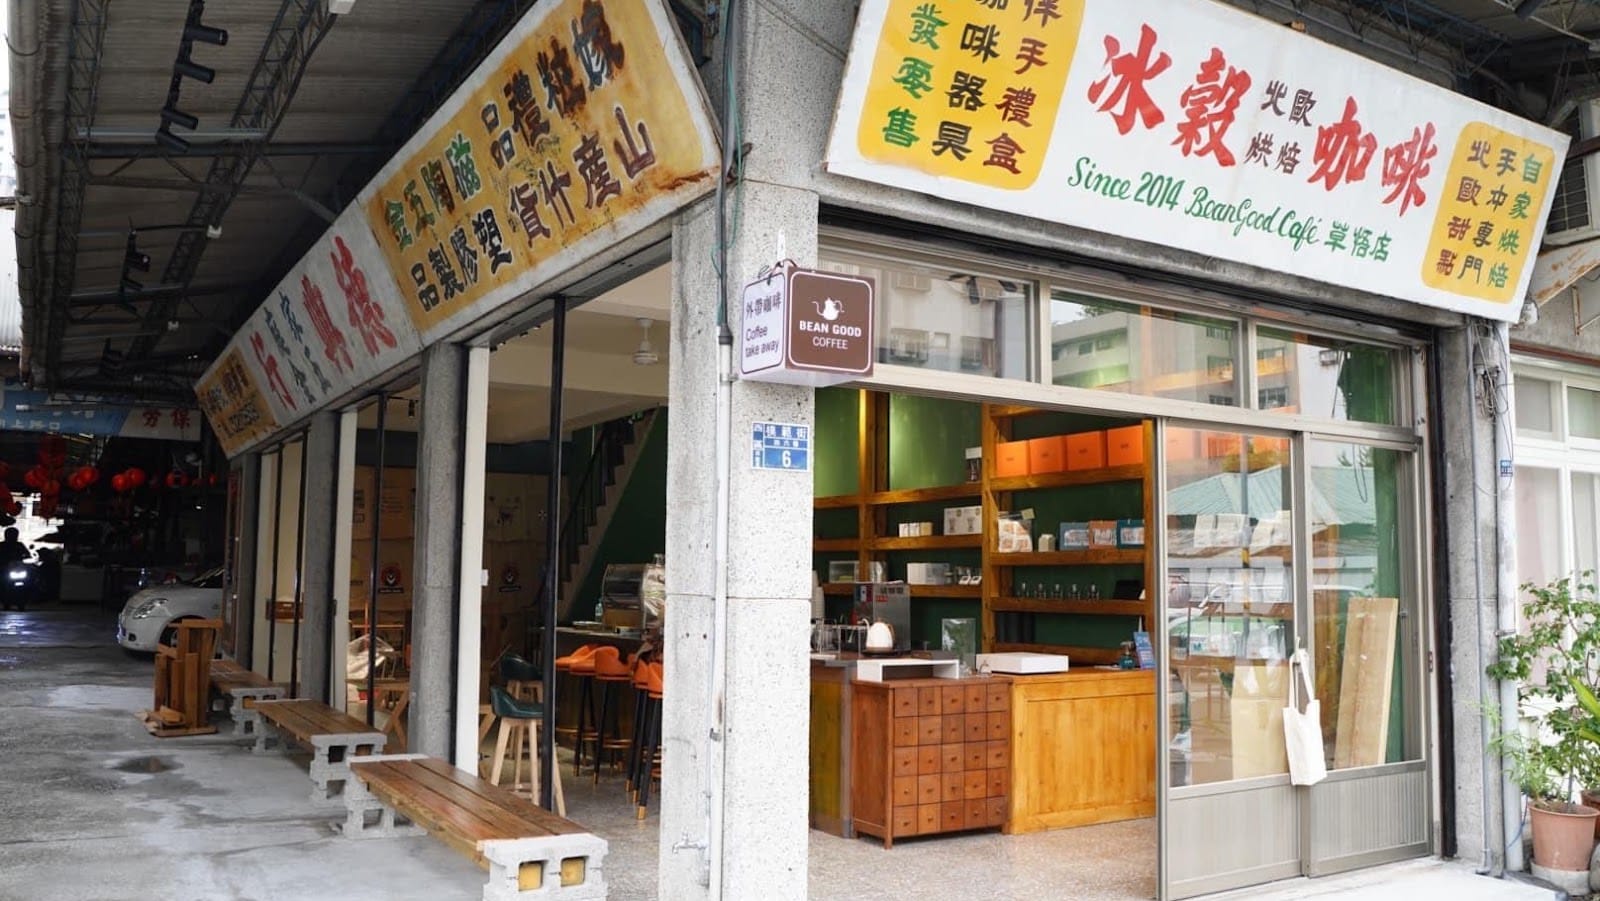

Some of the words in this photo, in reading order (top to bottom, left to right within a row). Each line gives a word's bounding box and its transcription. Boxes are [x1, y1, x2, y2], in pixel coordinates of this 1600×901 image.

[931, 0, 1008, 161] 啡器具
[1261, 80, 1316, 127] 北歐
[1243, 132, 1301, 174] 烘焙
[1308, 95, 1438, 216] 咖啡
[1068, 156, 1131, 201] Since
[1134, 171, 1186, 211] 2014
[1278, 209, 1322, 251] Café
[1324, 220, 1393, 262] 草悟店
[1437, 141, 1491, 276] 北歐甜點
[1488, 153, 1543, 288] 自家烘焙
[745, 343, 760, 358] take
[761, 340, 780, 355] away
[746, 325, 768, 341] Coffee
[799, 320, 829, 334] BEAN
[832, 324, 862, 337] GOOD
[812, 336, 849, 350] COFFEE
[782, 450, 791, 468] 6
